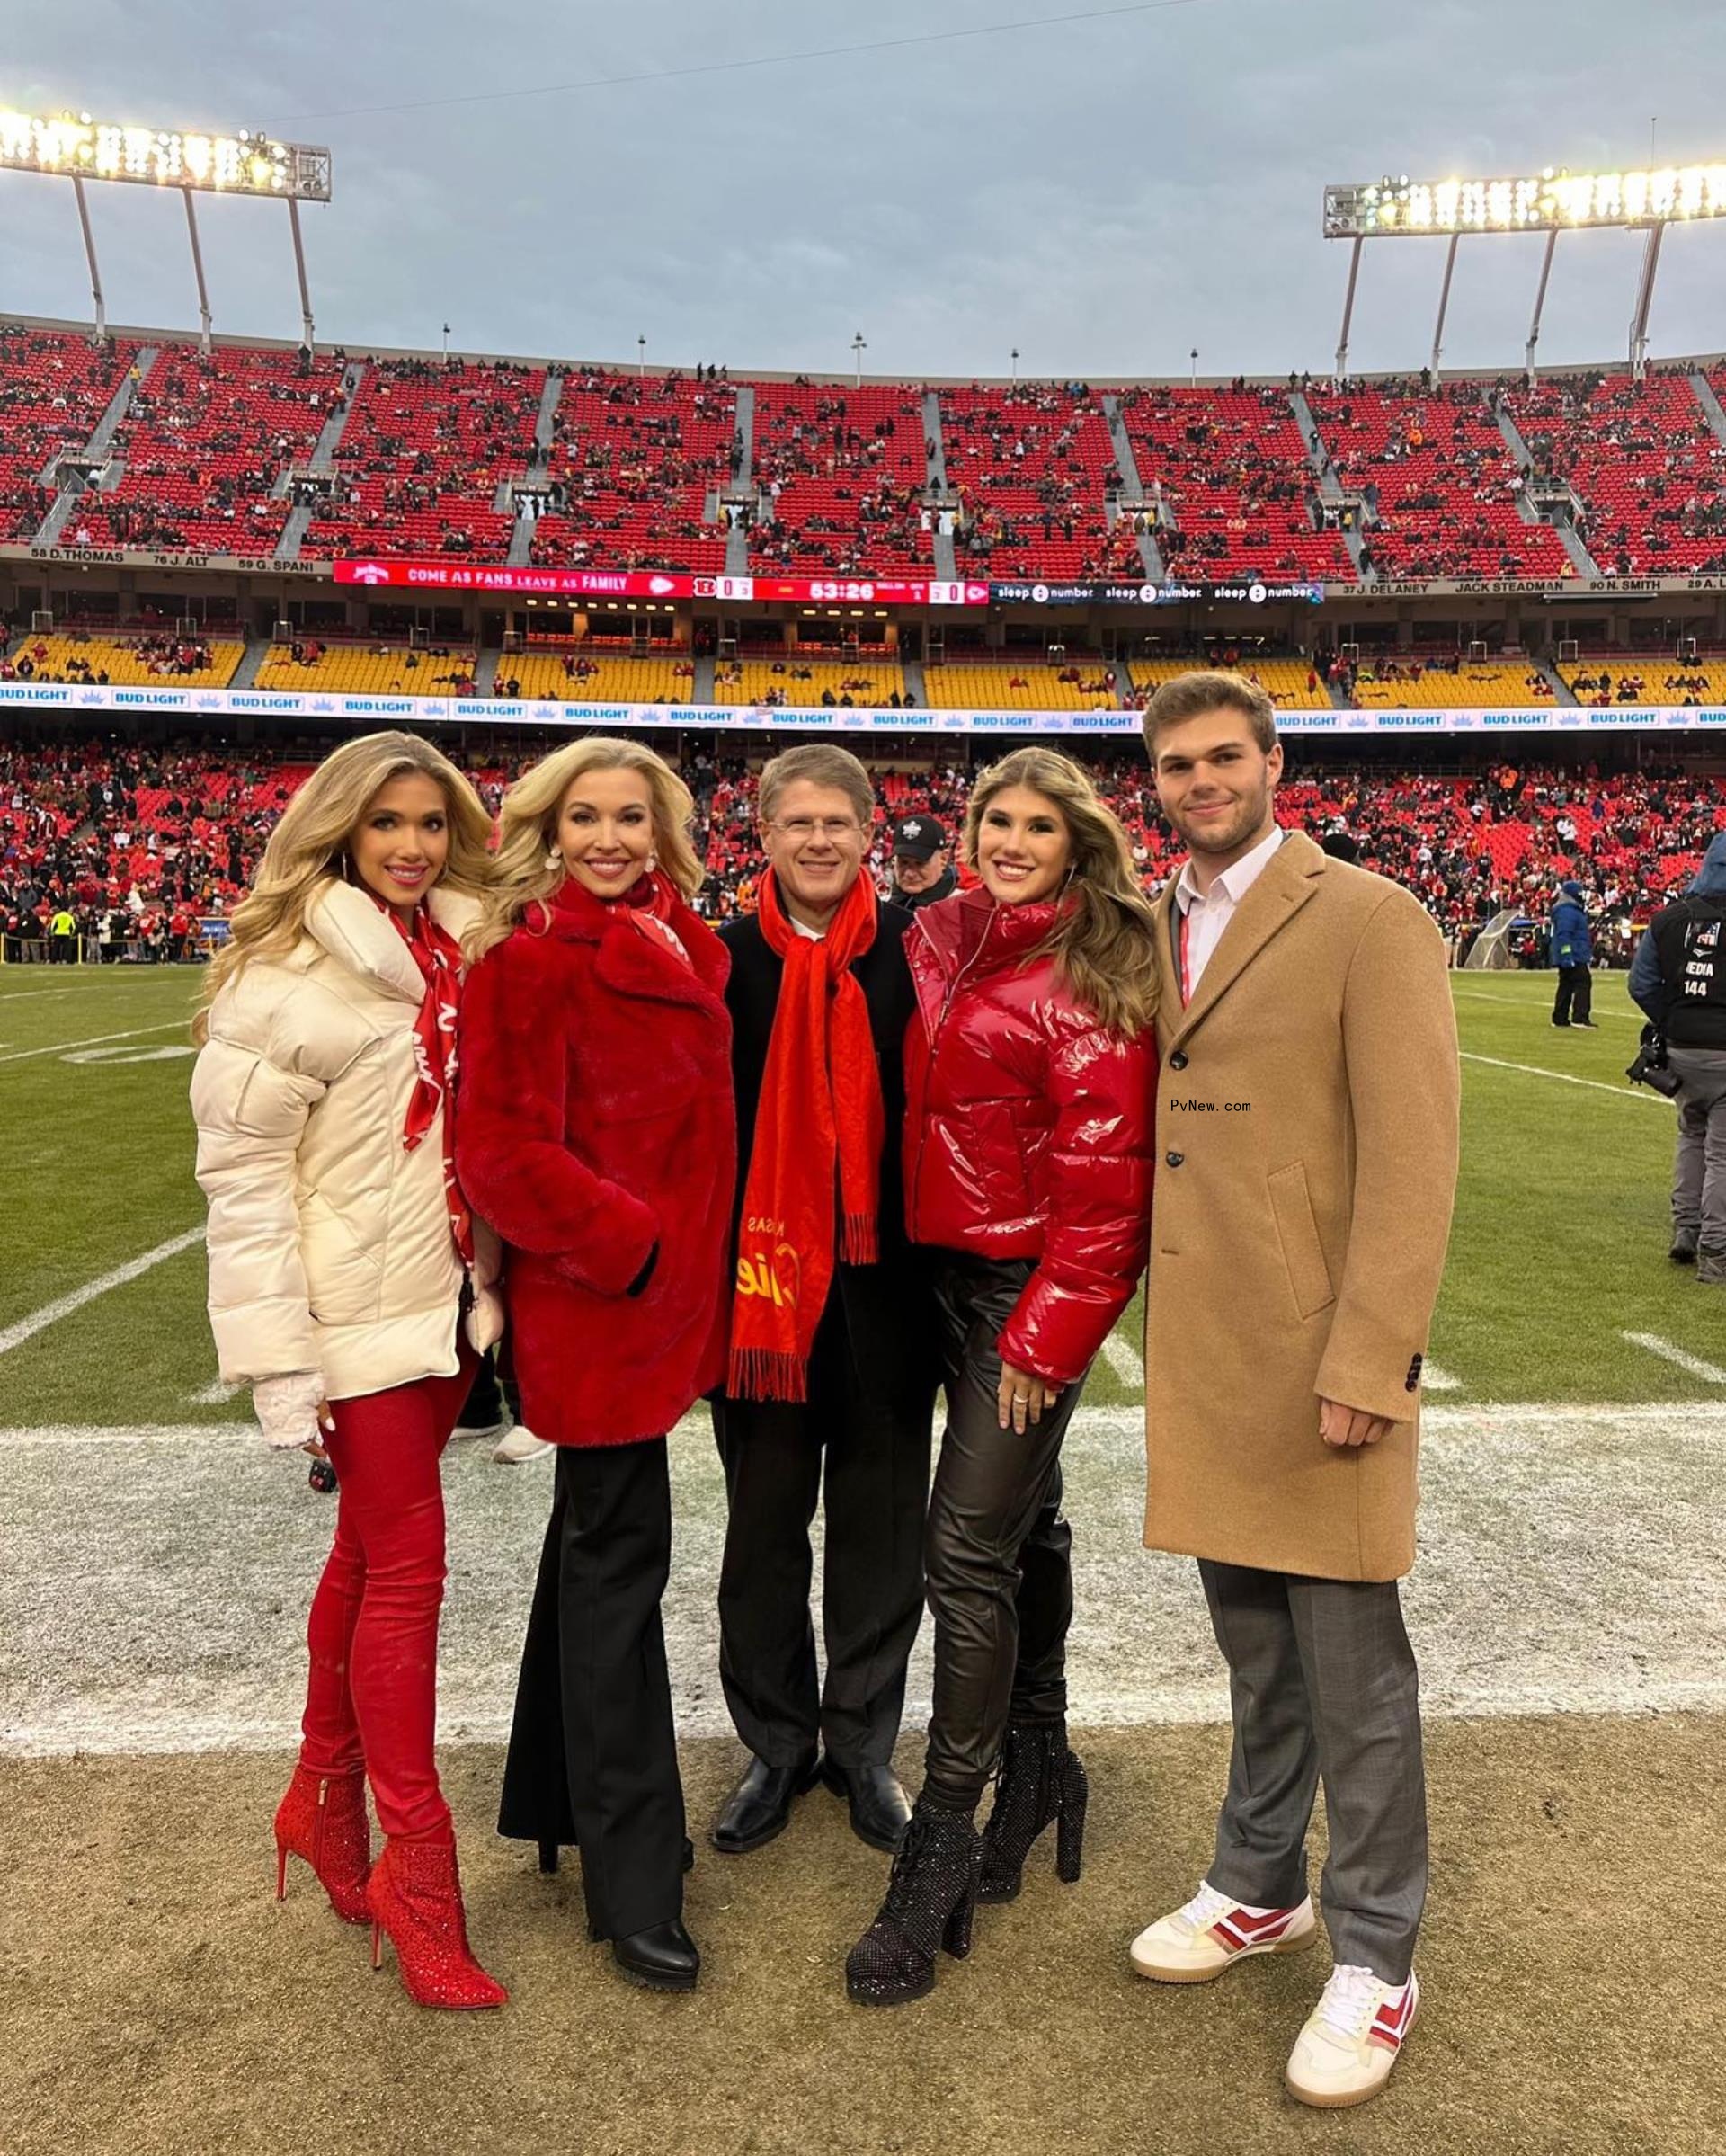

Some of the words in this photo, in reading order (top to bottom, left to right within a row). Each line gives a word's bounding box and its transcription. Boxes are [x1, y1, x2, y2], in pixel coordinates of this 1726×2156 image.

[31, 548, 46, 557] 58
[154, 555, 167, 565] 76
[185, 556, 209, 567] ALT
[238, 559, 253, 568] 59
[273, 561, 314, 572] SPANI
[408, 568, 447, 582] COME
[451, 571, 471, 583] AS
[476, 573, 512, 585] FANS
[517, 575, 556, 587] LEAVE
[562, 578, 577, 589] AS
[583, 575, 627, 590] FAMILY
[724, 579, 732, 596] 0
[810, 583, 875, 600] 53:26
[1370, 584, 1428, 594] DELANEY
[1455, 583, 1490, 592] JACK
[1492, 581, 1563, 592] STEADMAN
[1589, 581, 1604, 590] 90
[1622, 580, 1660, 591] SMITH
[949, 584, 958, 601] 0
[998, 587, 1029, 600] sleep
[1051, 588, 1093, 598] number
[1106, 587, 1137, 600] sleep
[1159, 586, 1201, 598] number
[1214, 586, 1247, 600] sleep
[1268, 586, 1313, 598] number
[28, 690, 68, 701] LIGHT
[115, 693, 144, 704] BUD
[147, 695, 186, 705] LIGHT
[231, 697, 258, 708] BUD
[260, 698, 300, 709] LIGHT
[345, 701, 374, 711] BUD
[375, 701, 413, 713] LIGHT
[458, 704, 485, 715] BUD
[486, 705, 523, 716] LIGHT
[565, 707, 592, 718] BUD
[593, 708, 629, 720] LIGHT
[670, 711, 695, 721] BUD
[697, 711, 733, 722] LIGHT
[772, 713, 796, 724] BUD
[798, 713, 834, 725] LIGHT
[873, 715, 898, 726] BUD
[900, 715, 935, 726] LIGHT
[974, 717, 998, 726] BUD
[1000, 717, 1034, 727] LIGHT
[1072, 717, 1098, 727] BUD
[1099, 717, 1133, 727] LIGHT
[1276, 717, 1300, 726] BUD
[1303, 717, 1338, 726] LIGHT
[1378, 717, 1404, 726] BUD
[1406, 716, 1442, 726] LIGHT
[1483, 716, 1509, 726] BUD
[1511, 715, 1548, 725] LIGHT
[1591, 714, 1618, 724] BUD
[1619, 713, 1656, 724] LIGHT
[1684, 980, 1707, 996] 144
